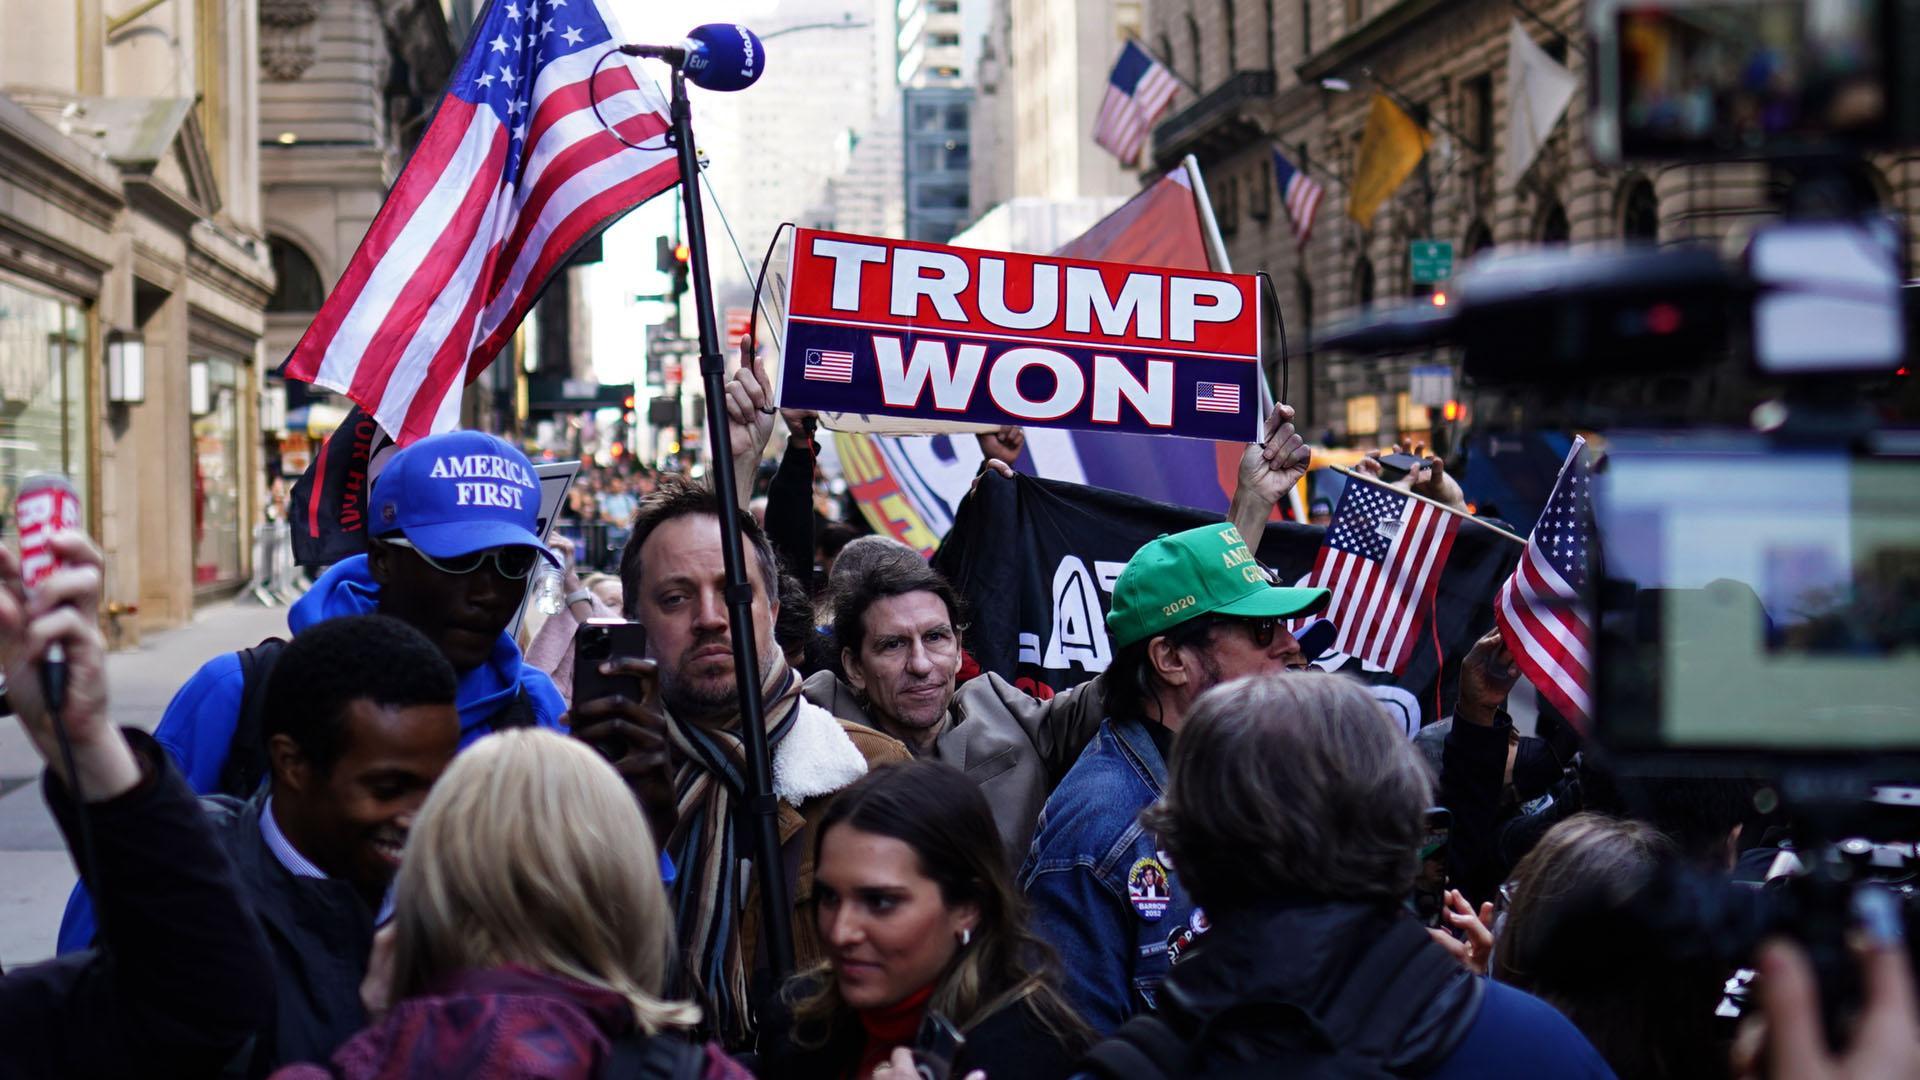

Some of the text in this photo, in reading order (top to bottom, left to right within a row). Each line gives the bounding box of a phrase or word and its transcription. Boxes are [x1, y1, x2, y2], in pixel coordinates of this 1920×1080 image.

[812, 238, 1243, 342] TRUMP
[872, 335, 1176, 427] WON
[429, 455, 535, 489] AMERICA
[455, 483, 523, 510] FIRST
[1162, 595, 1196, 616] 2020
[1138, 902, 1167, 911] BARRON
